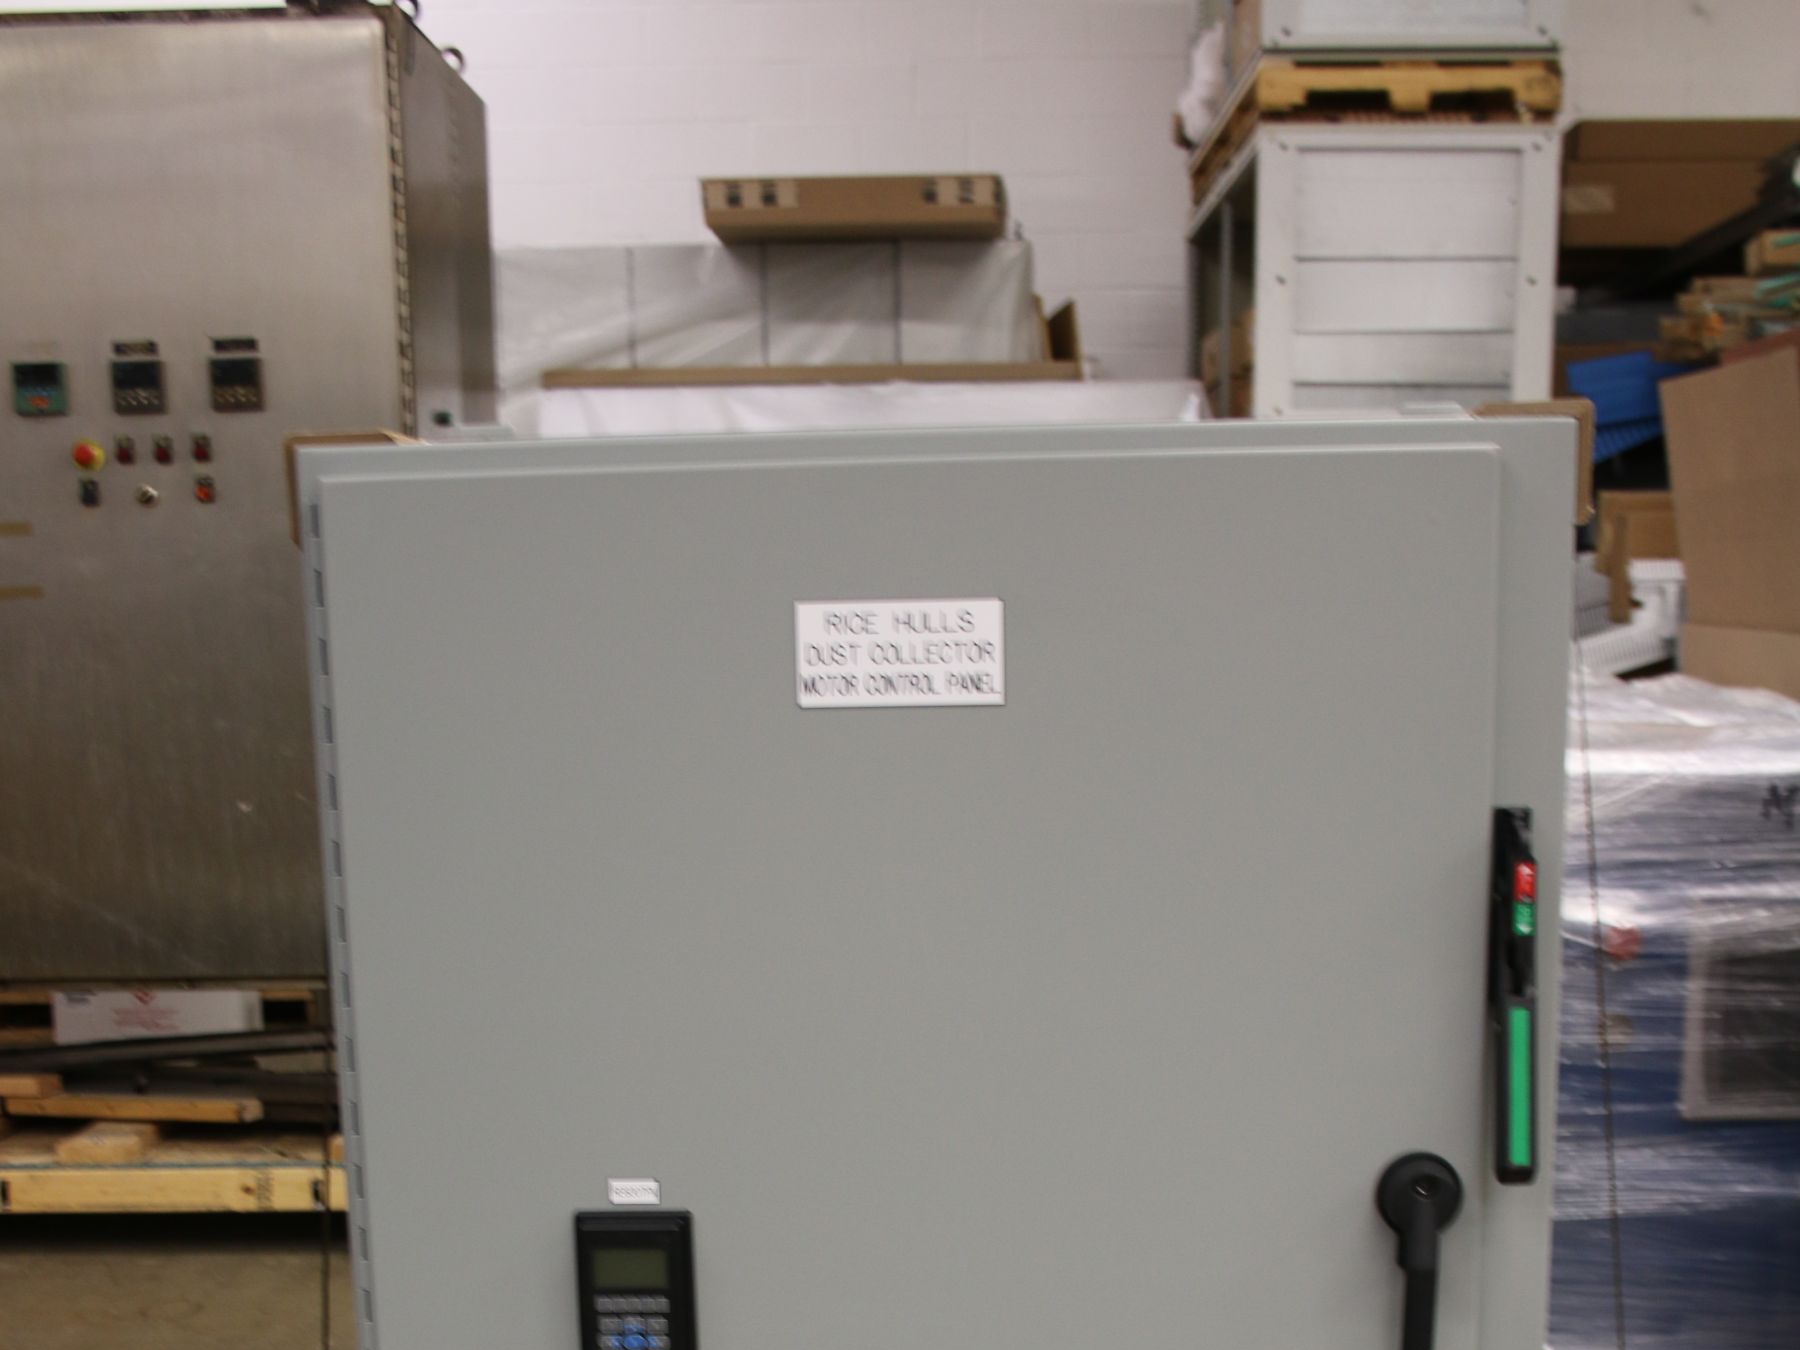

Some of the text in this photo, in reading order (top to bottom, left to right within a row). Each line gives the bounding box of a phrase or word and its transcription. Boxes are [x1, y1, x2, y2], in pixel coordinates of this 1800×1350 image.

[824, 608, 975, 635] RICE HULLS
[803, 639, 996, 666] DUST COLLECTOR
[801, 670, 1000, 697] MOTOR CONTROL PANEL
